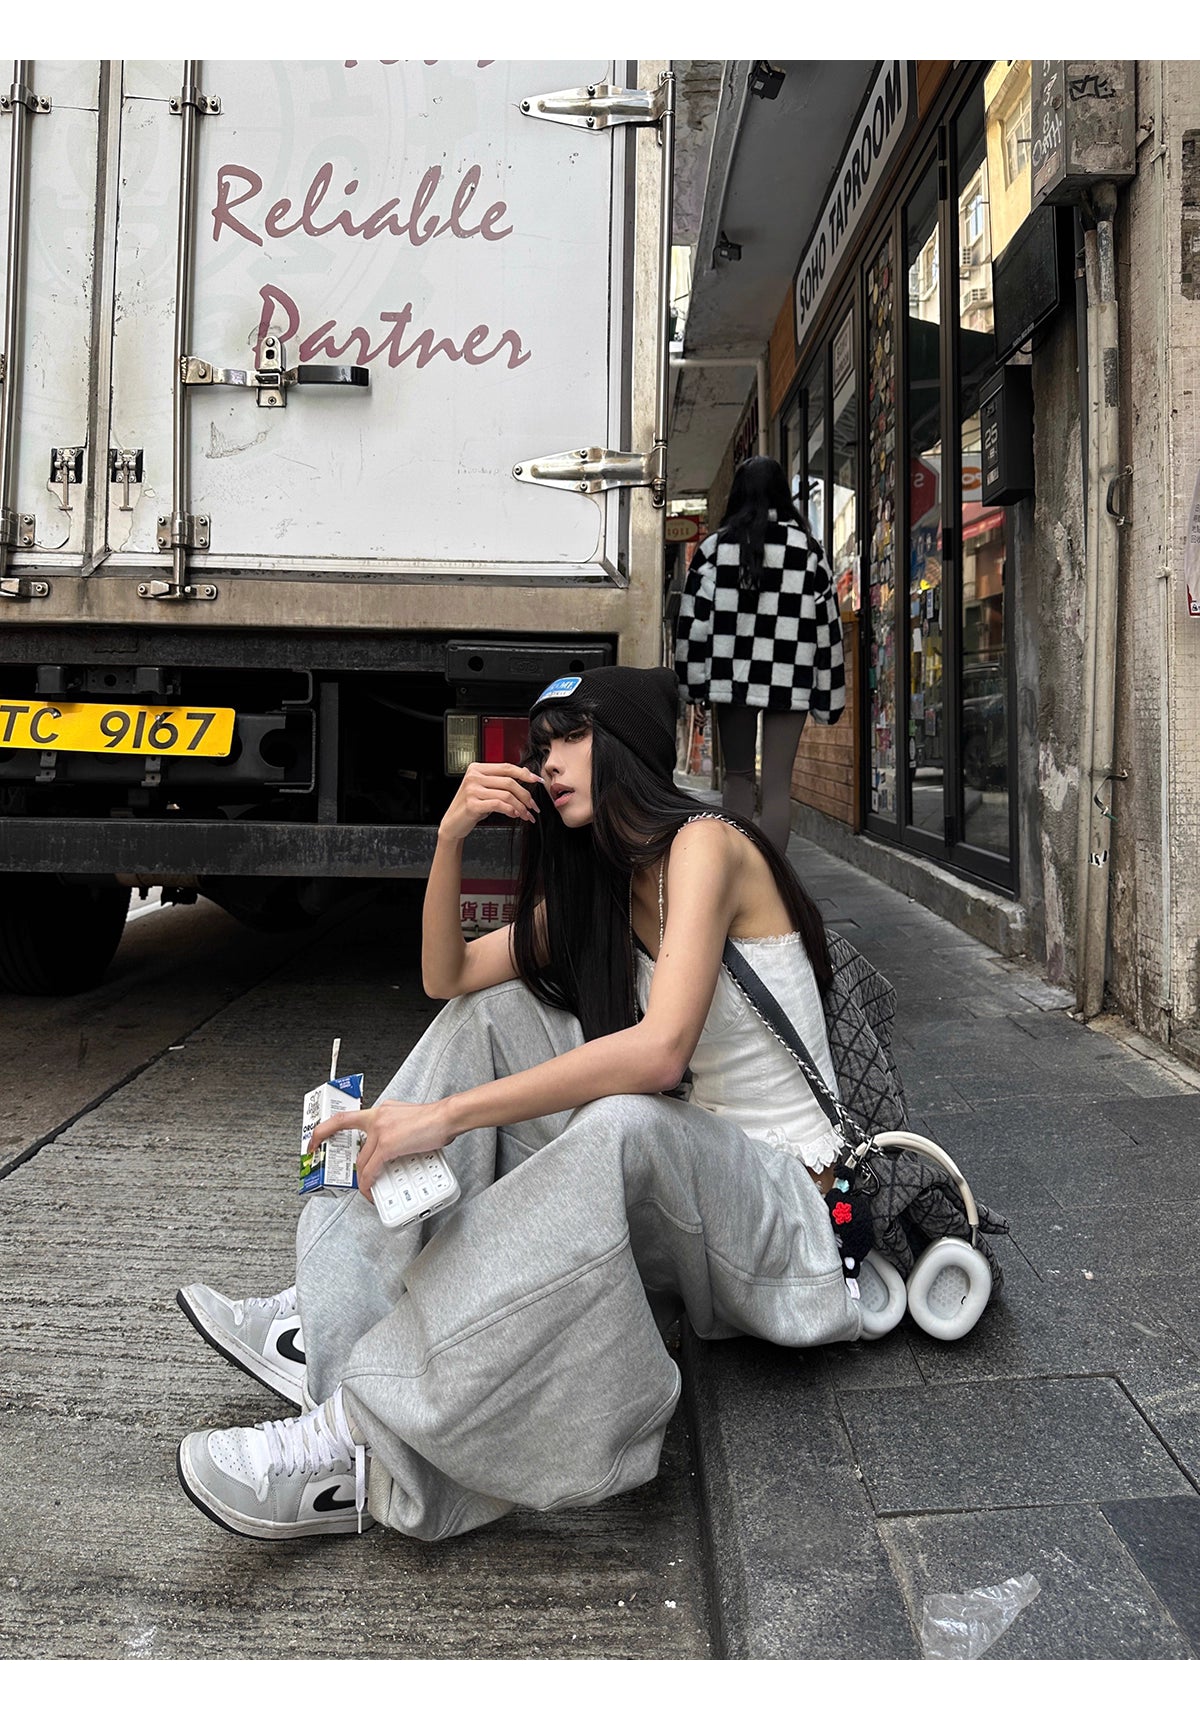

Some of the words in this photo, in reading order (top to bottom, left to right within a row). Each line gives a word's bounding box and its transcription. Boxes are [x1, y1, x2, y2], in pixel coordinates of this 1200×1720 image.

[211, 162, 513, 246] Reliable
[800, 232, 826, 325] SOHO
[828, 60, 902, 256] TAPROOM
[252, 284, 532, 369] Partner
[0, 705, 62, 744] TC
[100, 710, 217, 751] 9167
